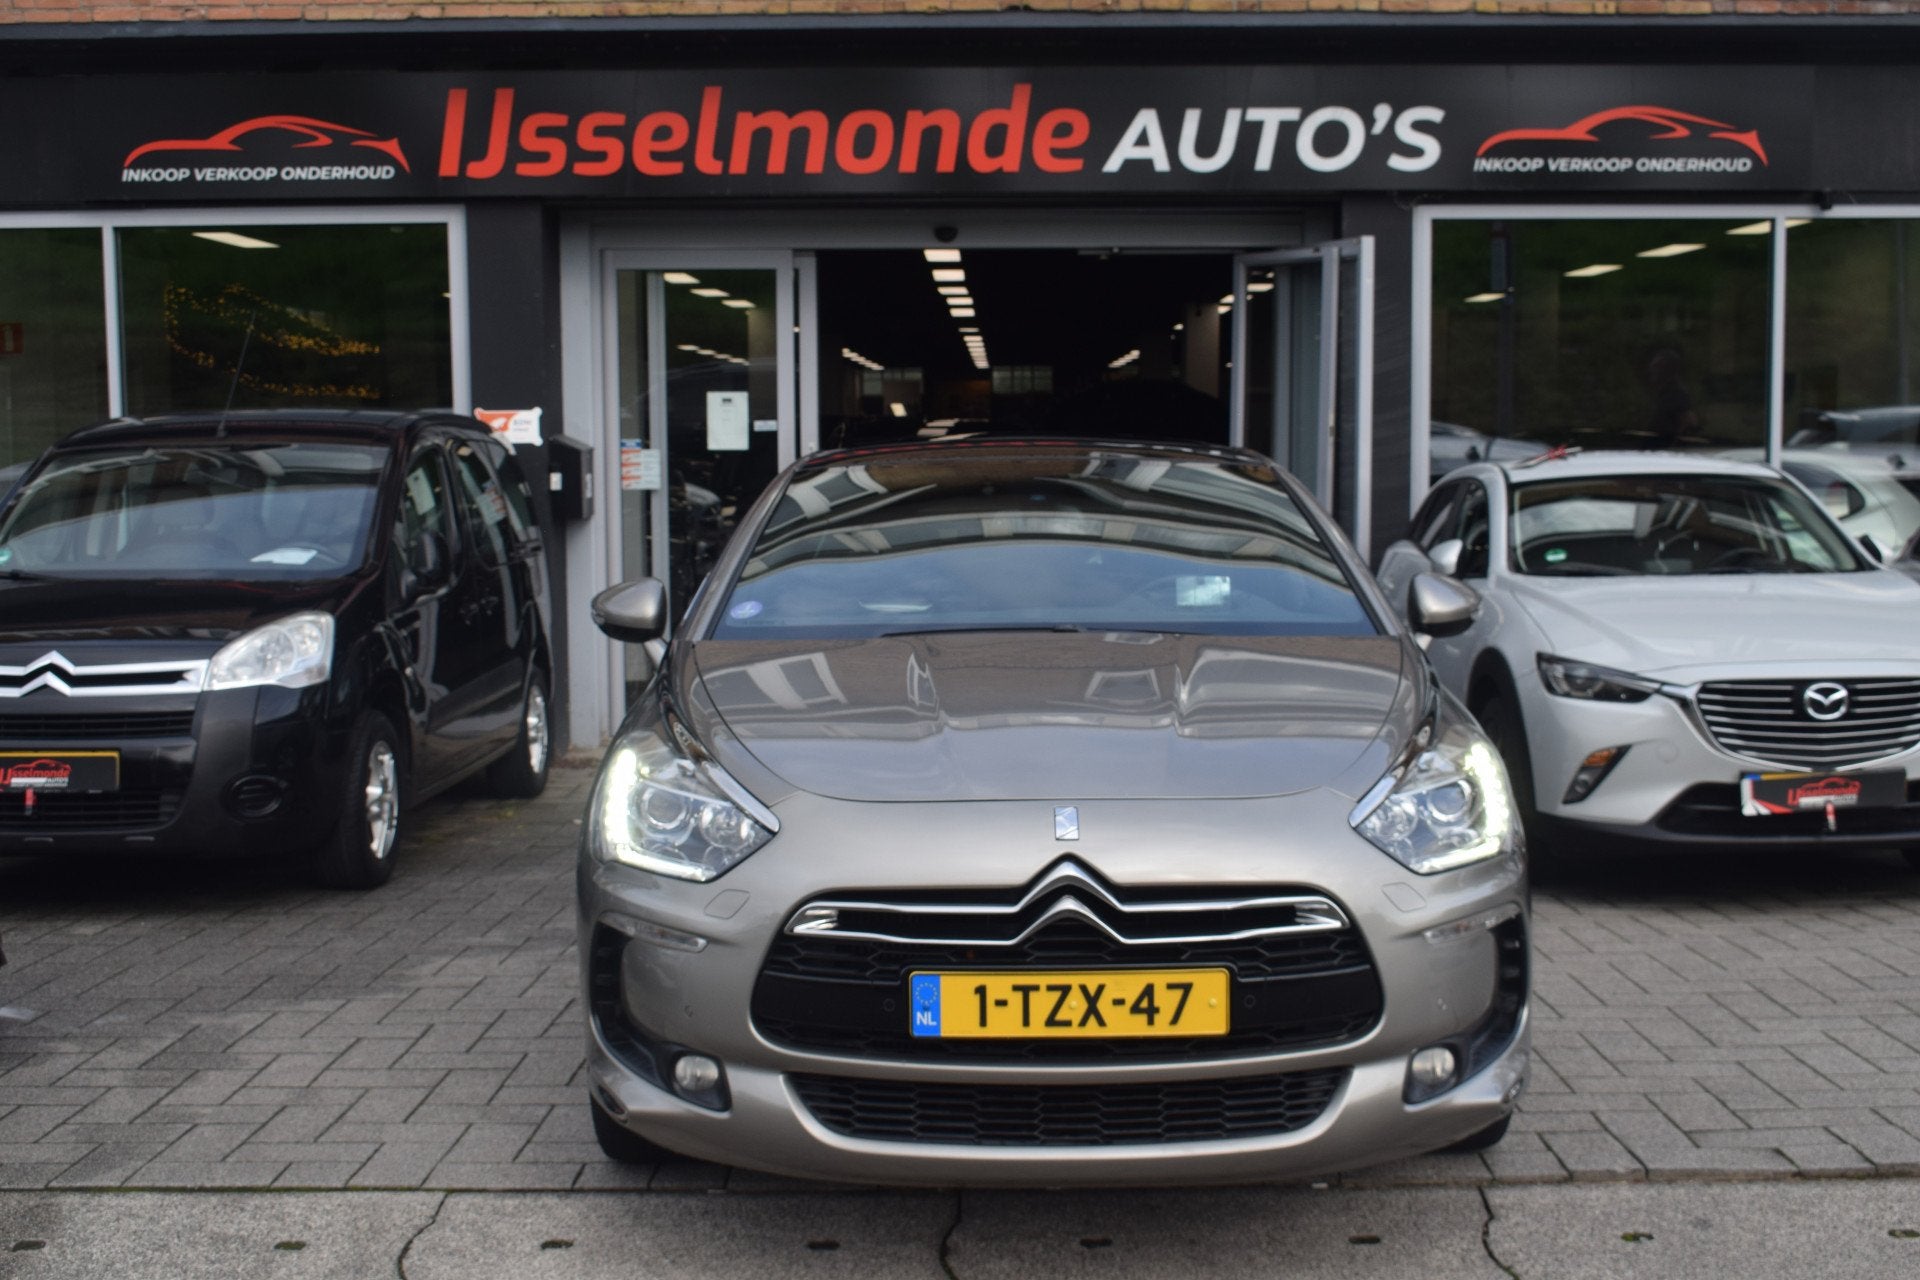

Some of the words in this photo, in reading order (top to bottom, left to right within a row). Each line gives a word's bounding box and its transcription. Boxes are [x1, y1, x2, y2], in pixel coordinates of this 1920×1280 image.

[440, 85, 1090, 179] IJsselmonde
[1102, 103, 1446, 173] AUTO'S
[1472, 157, 1544, 172] INKOOP
[1547, 157, 1634, 172] VERKOOP
[1635, 157, 1753, 172] ONDERHOUD
[121, 168, 190, 182] INKOOP
[193, 167, 278, 181] VERKOOP
[280, 165, 396, 180] ONDERHOUD
[973, 982, 1194, 1028] 1-TZX-47
[916, 1011, 937, 1026] NL
